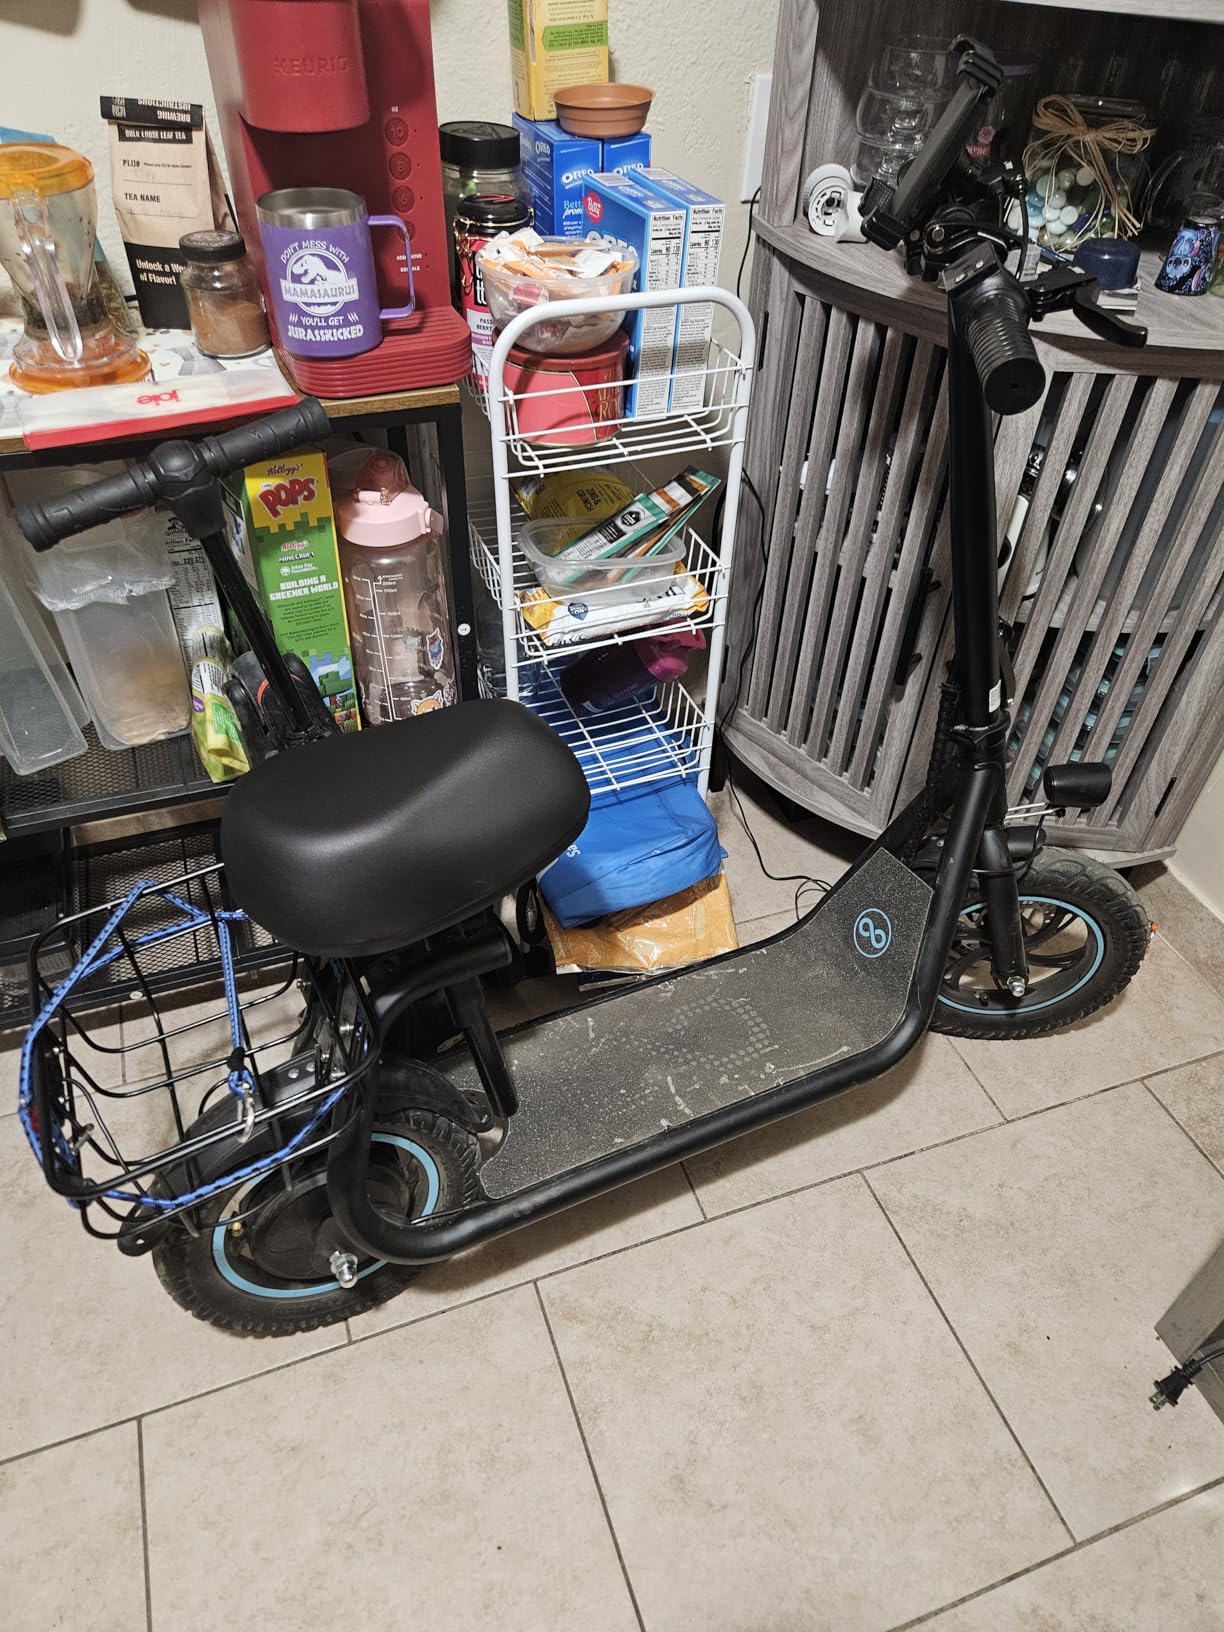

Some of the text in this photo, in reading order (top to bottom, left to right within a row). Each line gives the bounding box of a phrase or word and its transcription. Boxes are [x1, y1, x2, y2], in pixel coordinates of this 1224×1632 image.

[273, 56, 351, 76] KEURIG
[157, 111, 191, 123] BREWING
[125, 130, 186, 139] BULK LOOSE LEAF TEA
[391, 127, 403, 138] 10
[125, 193, 160, 203] TEA NAME
[281, 240, 350, 264] DON'T MESS WITH
[136, 259, 163, 272] Unlock
[165, 264, 170, 272] a
[140, 273, 147, 281] of
[284, 285, 355, 299] MAMASAURUS
[300, 316, 344, 326] YOU'LL GET
[288, 325, 364, 342] JURASSKICKED
[267, 464, 303, 476] Kellogg's
[258, 477, 317, 518] POPS
[279, 552, 315, 563] MINECRAFT
[280, 576, 319, 590] BUILDING
[269, 581, 339, 601] GREENER WORLD
